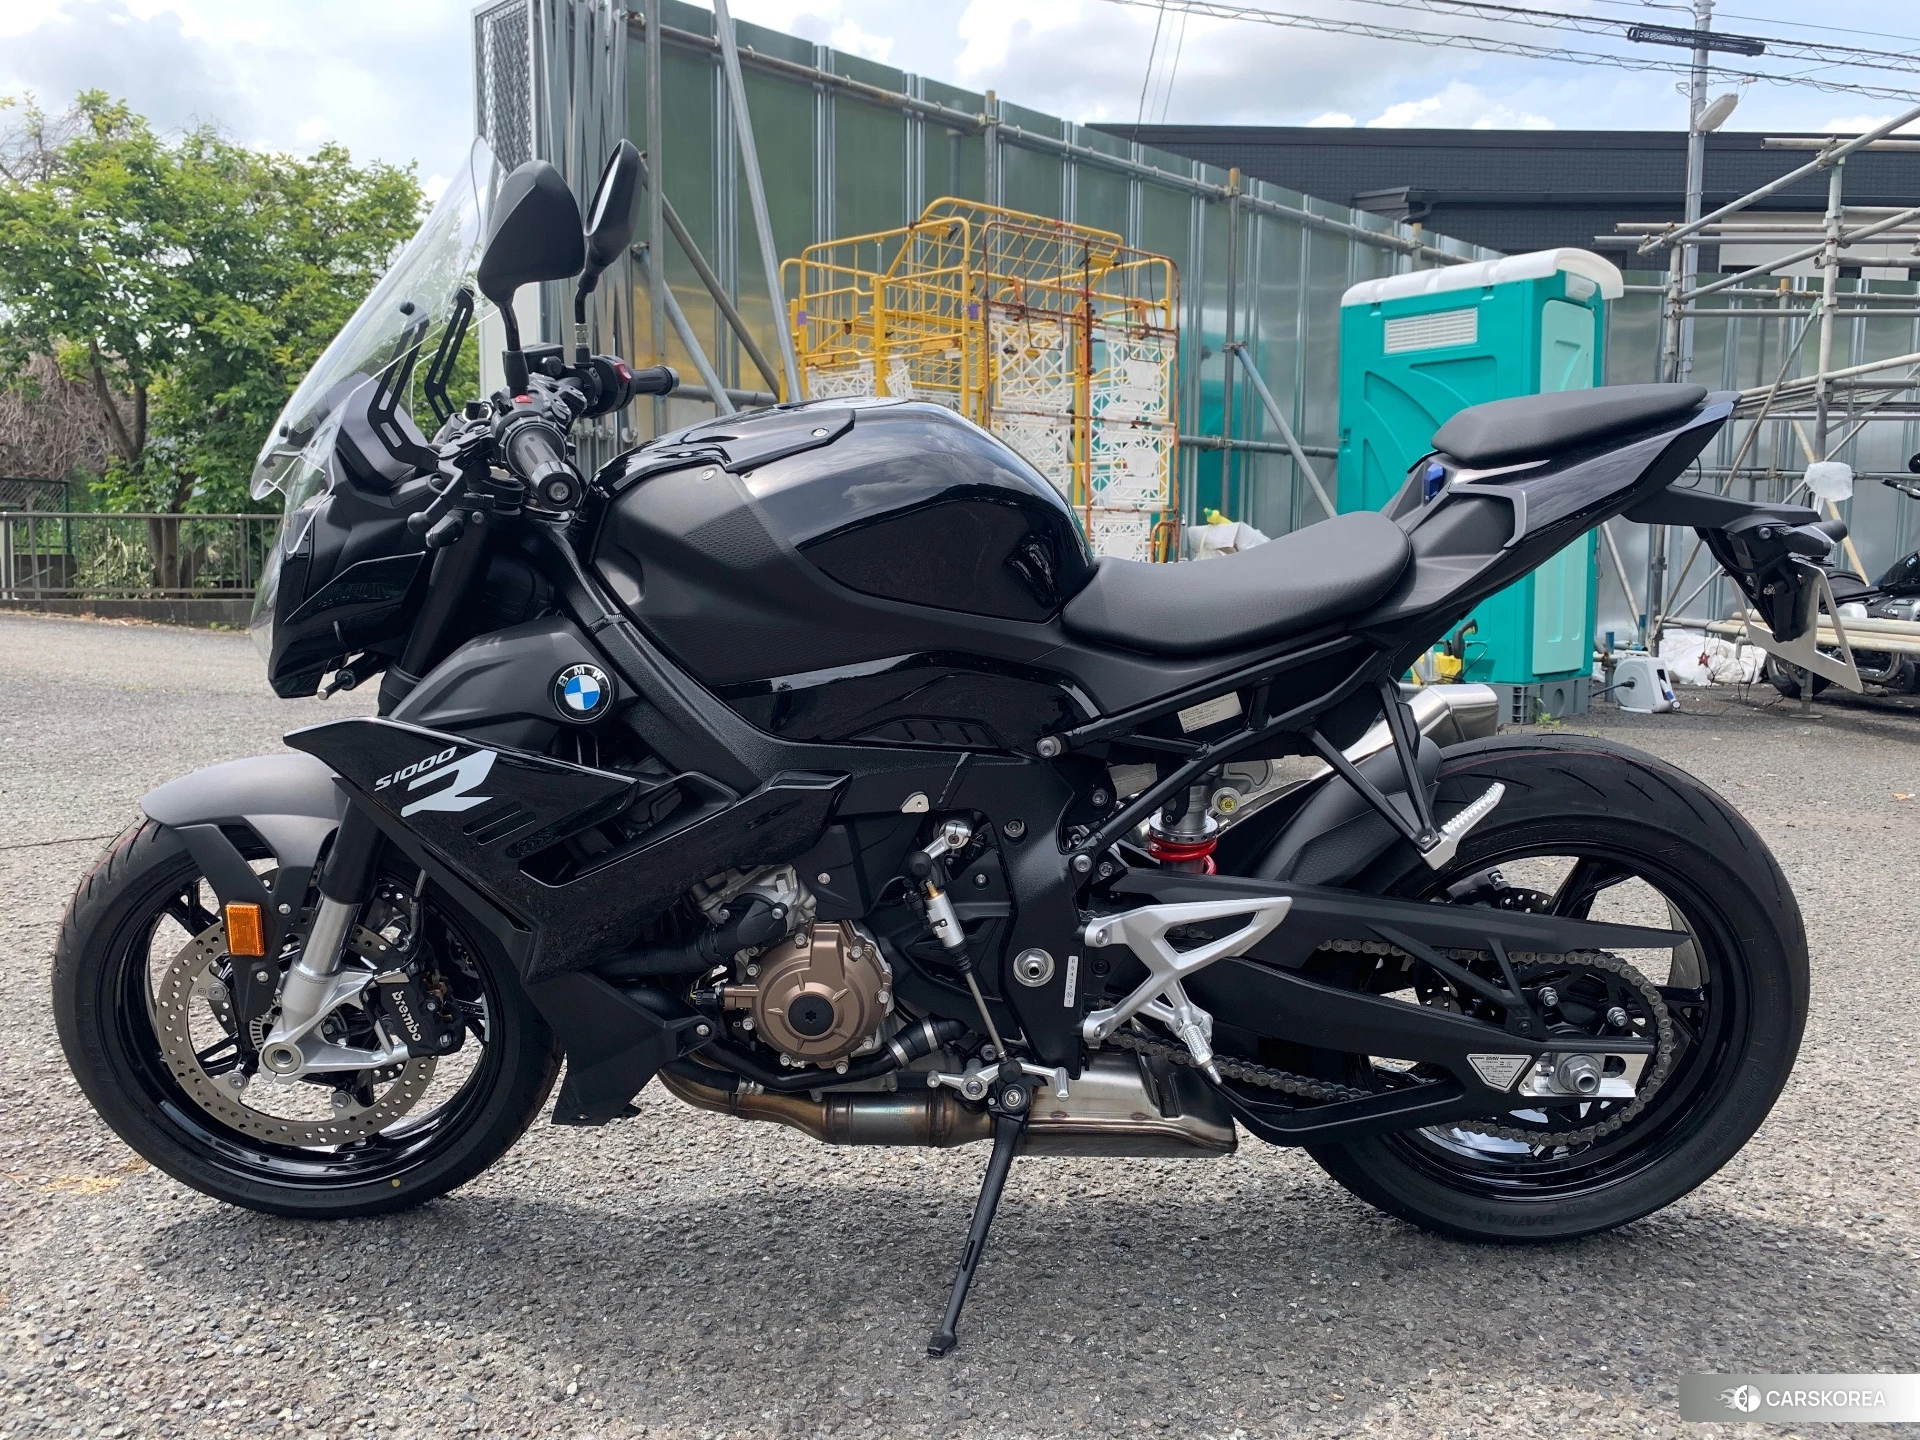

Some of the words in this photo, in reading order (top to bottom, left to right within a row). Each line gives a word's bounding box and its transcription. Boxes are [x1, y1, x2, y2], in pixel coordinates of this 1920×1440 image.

[557, 666, 604, 687] BMW
[374, 746, 458, 792] S1000
[391, 990, 422, 1042] brembo
[1686, 1062, 1769, 1166] BRIDGESTONE
